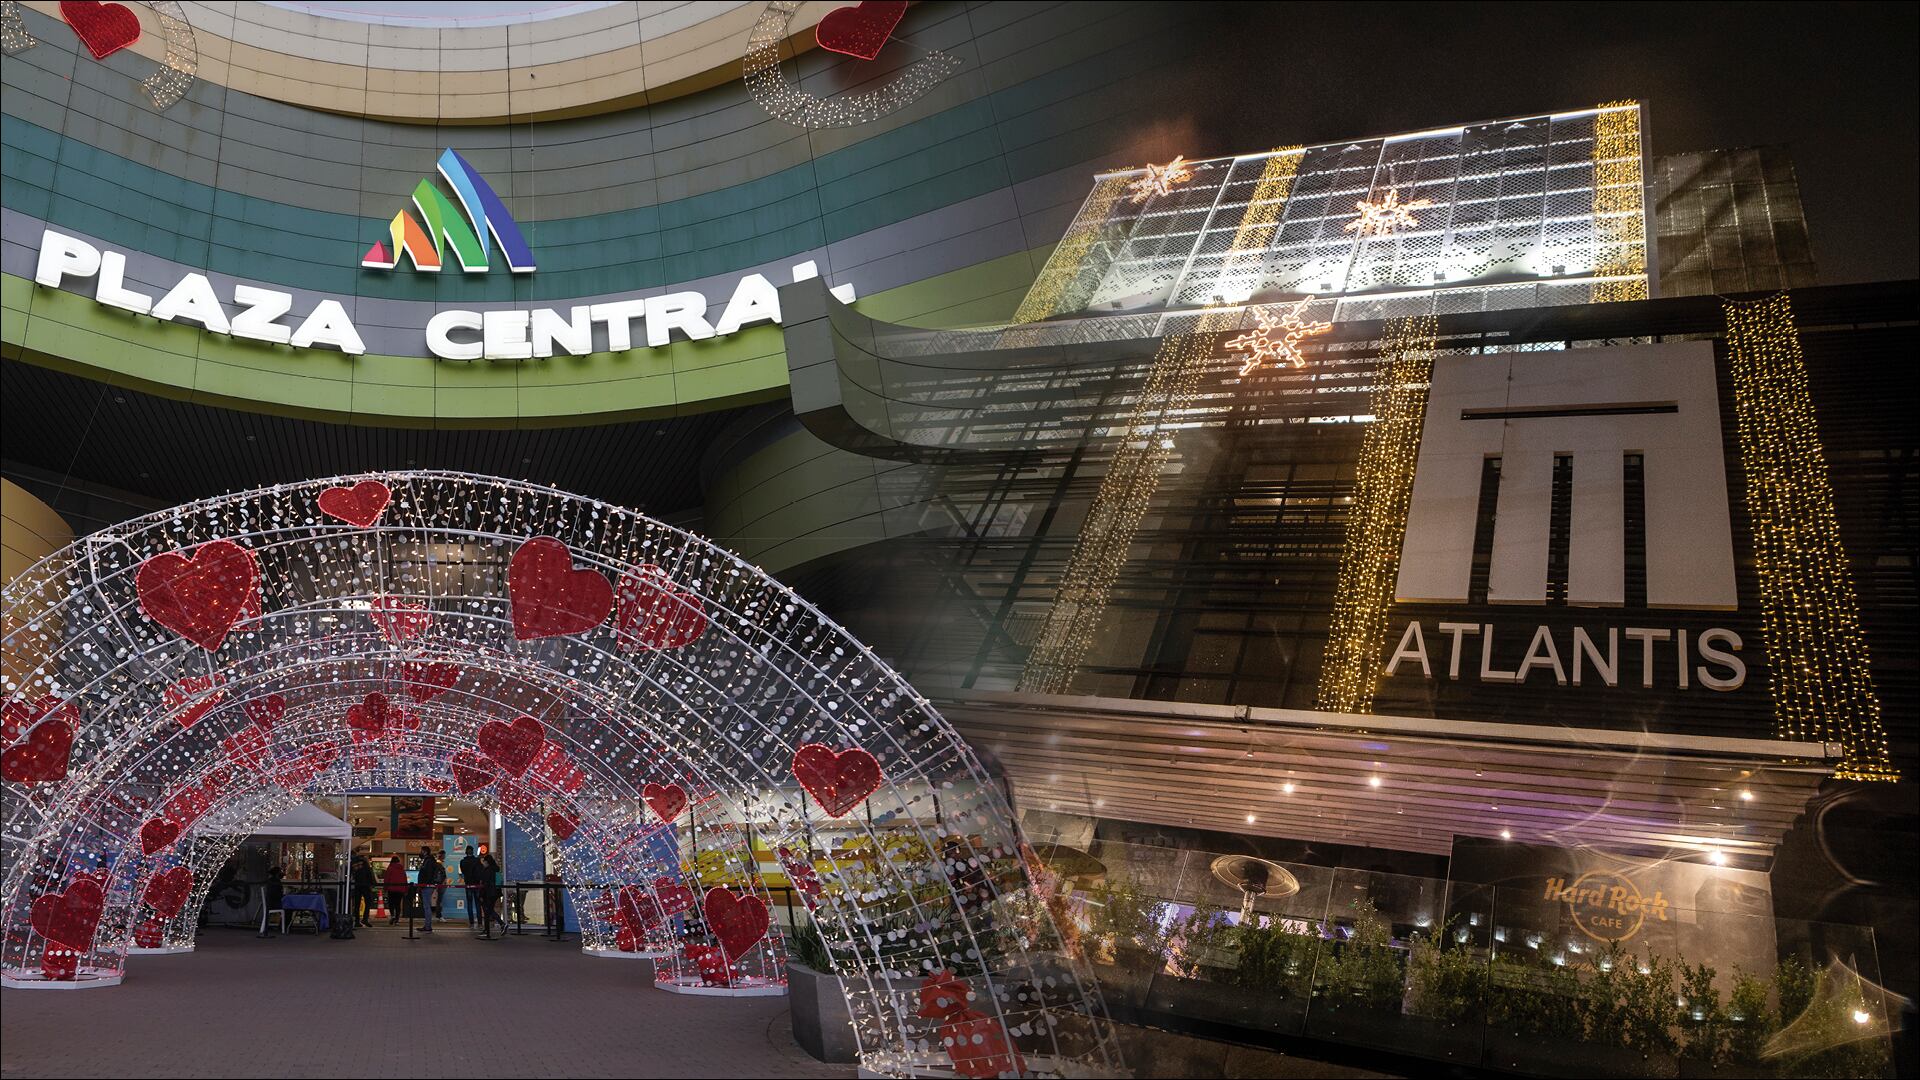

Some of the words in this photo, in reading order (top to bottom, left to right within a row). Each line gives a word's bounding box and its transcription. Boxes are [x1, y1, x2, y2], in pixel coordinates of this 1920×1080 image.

[35, 229, 366, 355] PLAZA
[1385, 620, 1747, 692] ATLANTIS
[1544, 878, 1606, 907] Hard
[1609, 886, 1669, 921] Rock
[1591, 916, 1622, 929] CAFE
